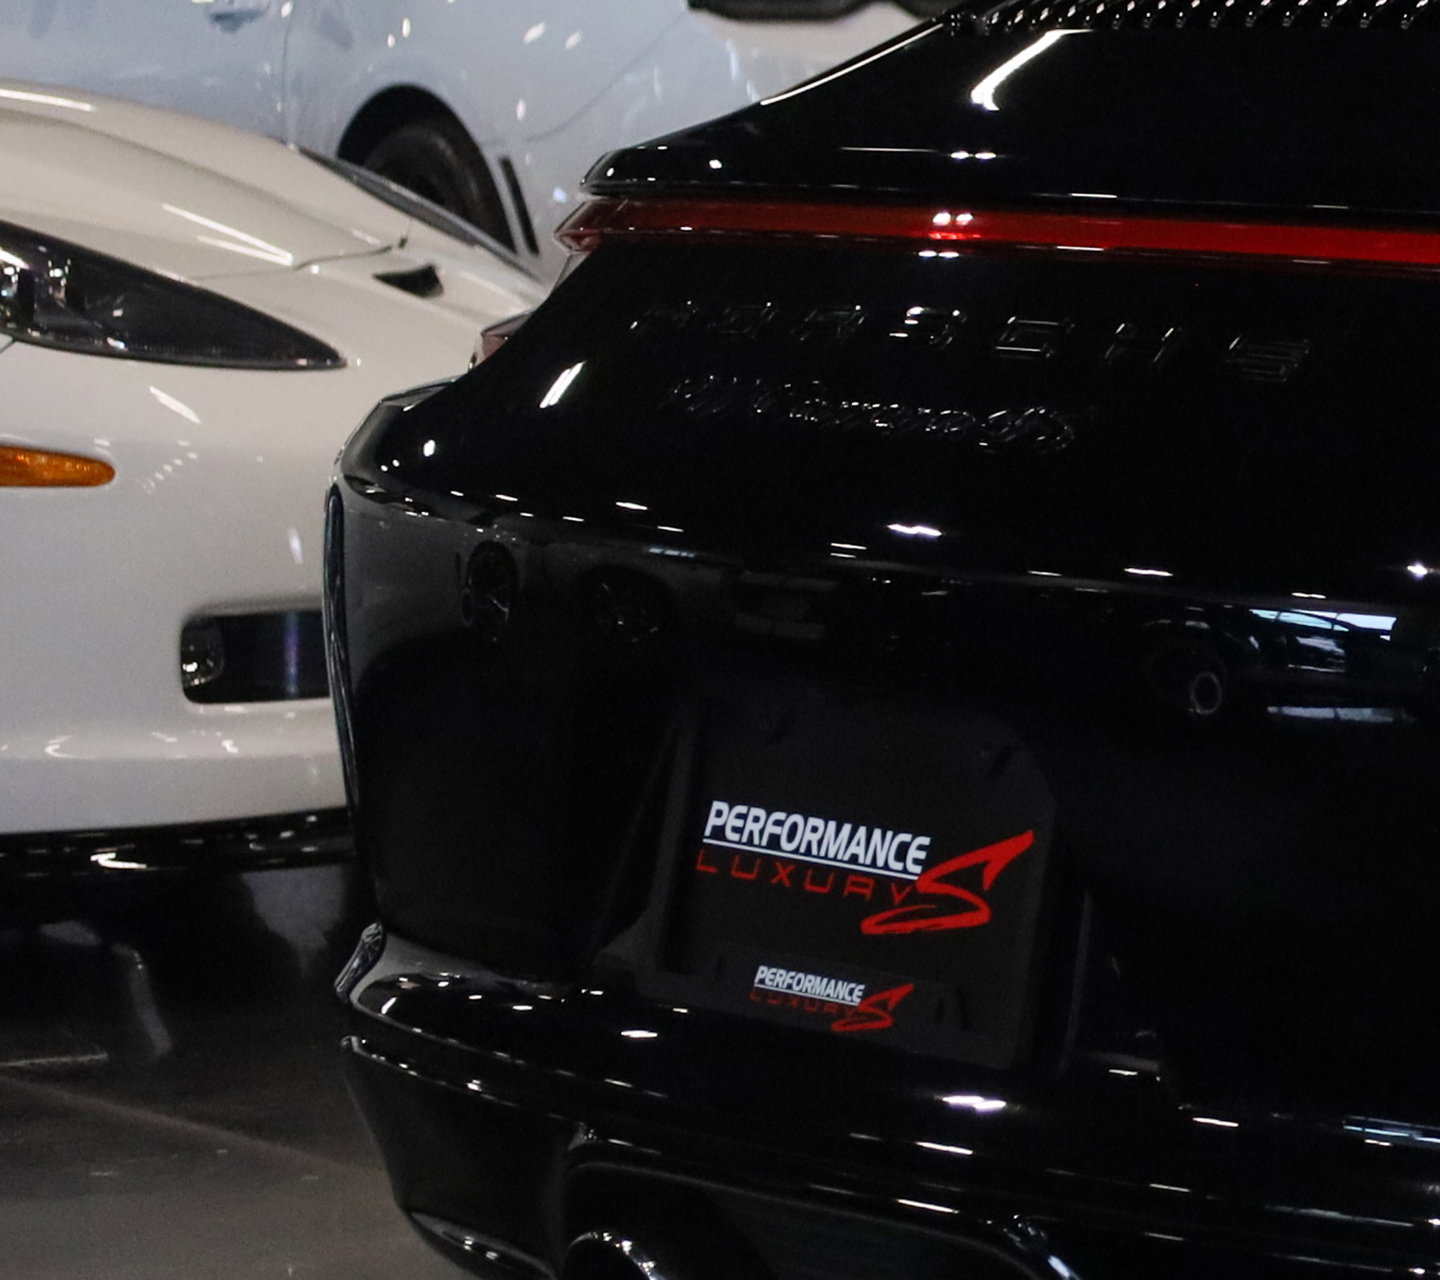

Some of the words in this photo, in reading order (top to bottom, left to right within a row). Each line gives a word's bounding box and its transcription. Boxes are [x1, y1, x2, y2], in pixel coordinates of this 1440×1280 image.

[620, 297, 1314, 384] PORSCHE
[703, 799, 932, 874] PERFORMANCE
[695, 849, 914, 907] LUXURY
[753, 964, 866, 1003] PERFORMANCE
